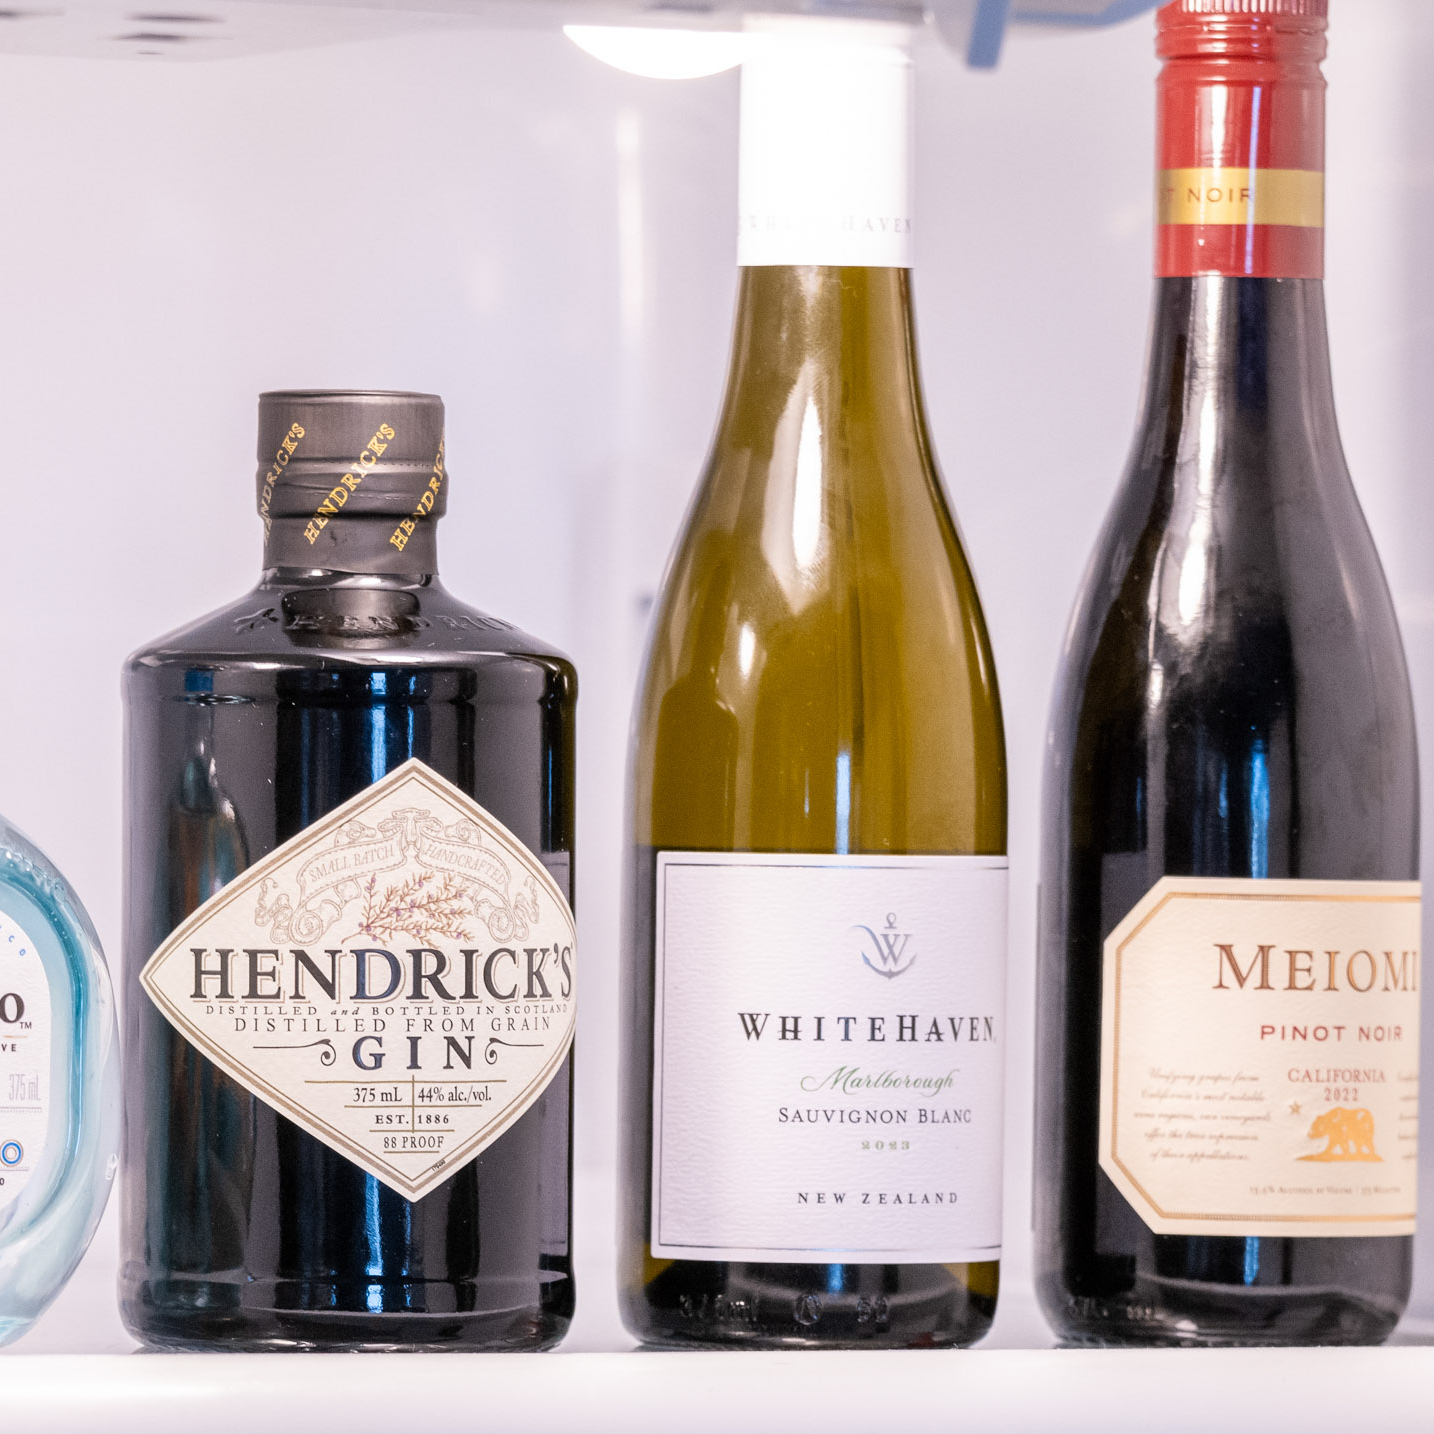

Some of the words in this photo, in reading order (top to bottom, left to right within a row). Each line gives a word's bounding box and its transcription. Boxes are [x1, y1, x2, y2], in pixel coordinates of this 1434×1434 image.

[303, 422, 396, 545] HENDRICK'S
[309, 857, 352, 883] SMALL
[354, 844, 395, 867] BATCH
[423, 843, 507, 886] HANDCRAFTED
[188, 942, 573, 1003] HENDRICK'S
[1211, 942, 1419, 993] MEIOMI
[205, 1005, 318, 1016] DISTILLED
[330, 1005, 360, 1017] and
[371, 1005, 466, 1016] BOTTLED
[475, 1005, 494, 1015] IN
[503, 1003, 568, 1015] SCOTLAND
[234, 1016, 387, 1033] DISTILLED
[405, 1016, 476, 1033] FROM
[490, 1015, 551, 1032] GRAIN
[1260, 1025, 1347, 1042] PINOT
[1358, 1025, 1403, 1042] NOIR
[351, 1035, 476, 1071] GIN
[800, 1065, 962, 1098] Marlborough
[1287, 1068, 1386, 1084] CALIFORNIA
[352, 1086, 377, 1103] 375
[380, 1086, 403, 1102] mL
[417, 1086, 445, 1103] 44%
[447, 1085, 492, 1104] alc./vol.
[1323, 1087, 1360, 1102] 2022
[374, 1114, 409, 1126] EST.
[417, 1114, 450, 1126] 1886
[777, 1107, 908, 1125] SAUVIGNON
[918, 1108, 972, 1125] BLANC
[383, 1136, 399, 1150] 88
[401, 1135, 445, 1150] PROOF
[797, 1192, 847, 1205] NEW
[861, 1192, 959, 1205] ZEALAND
